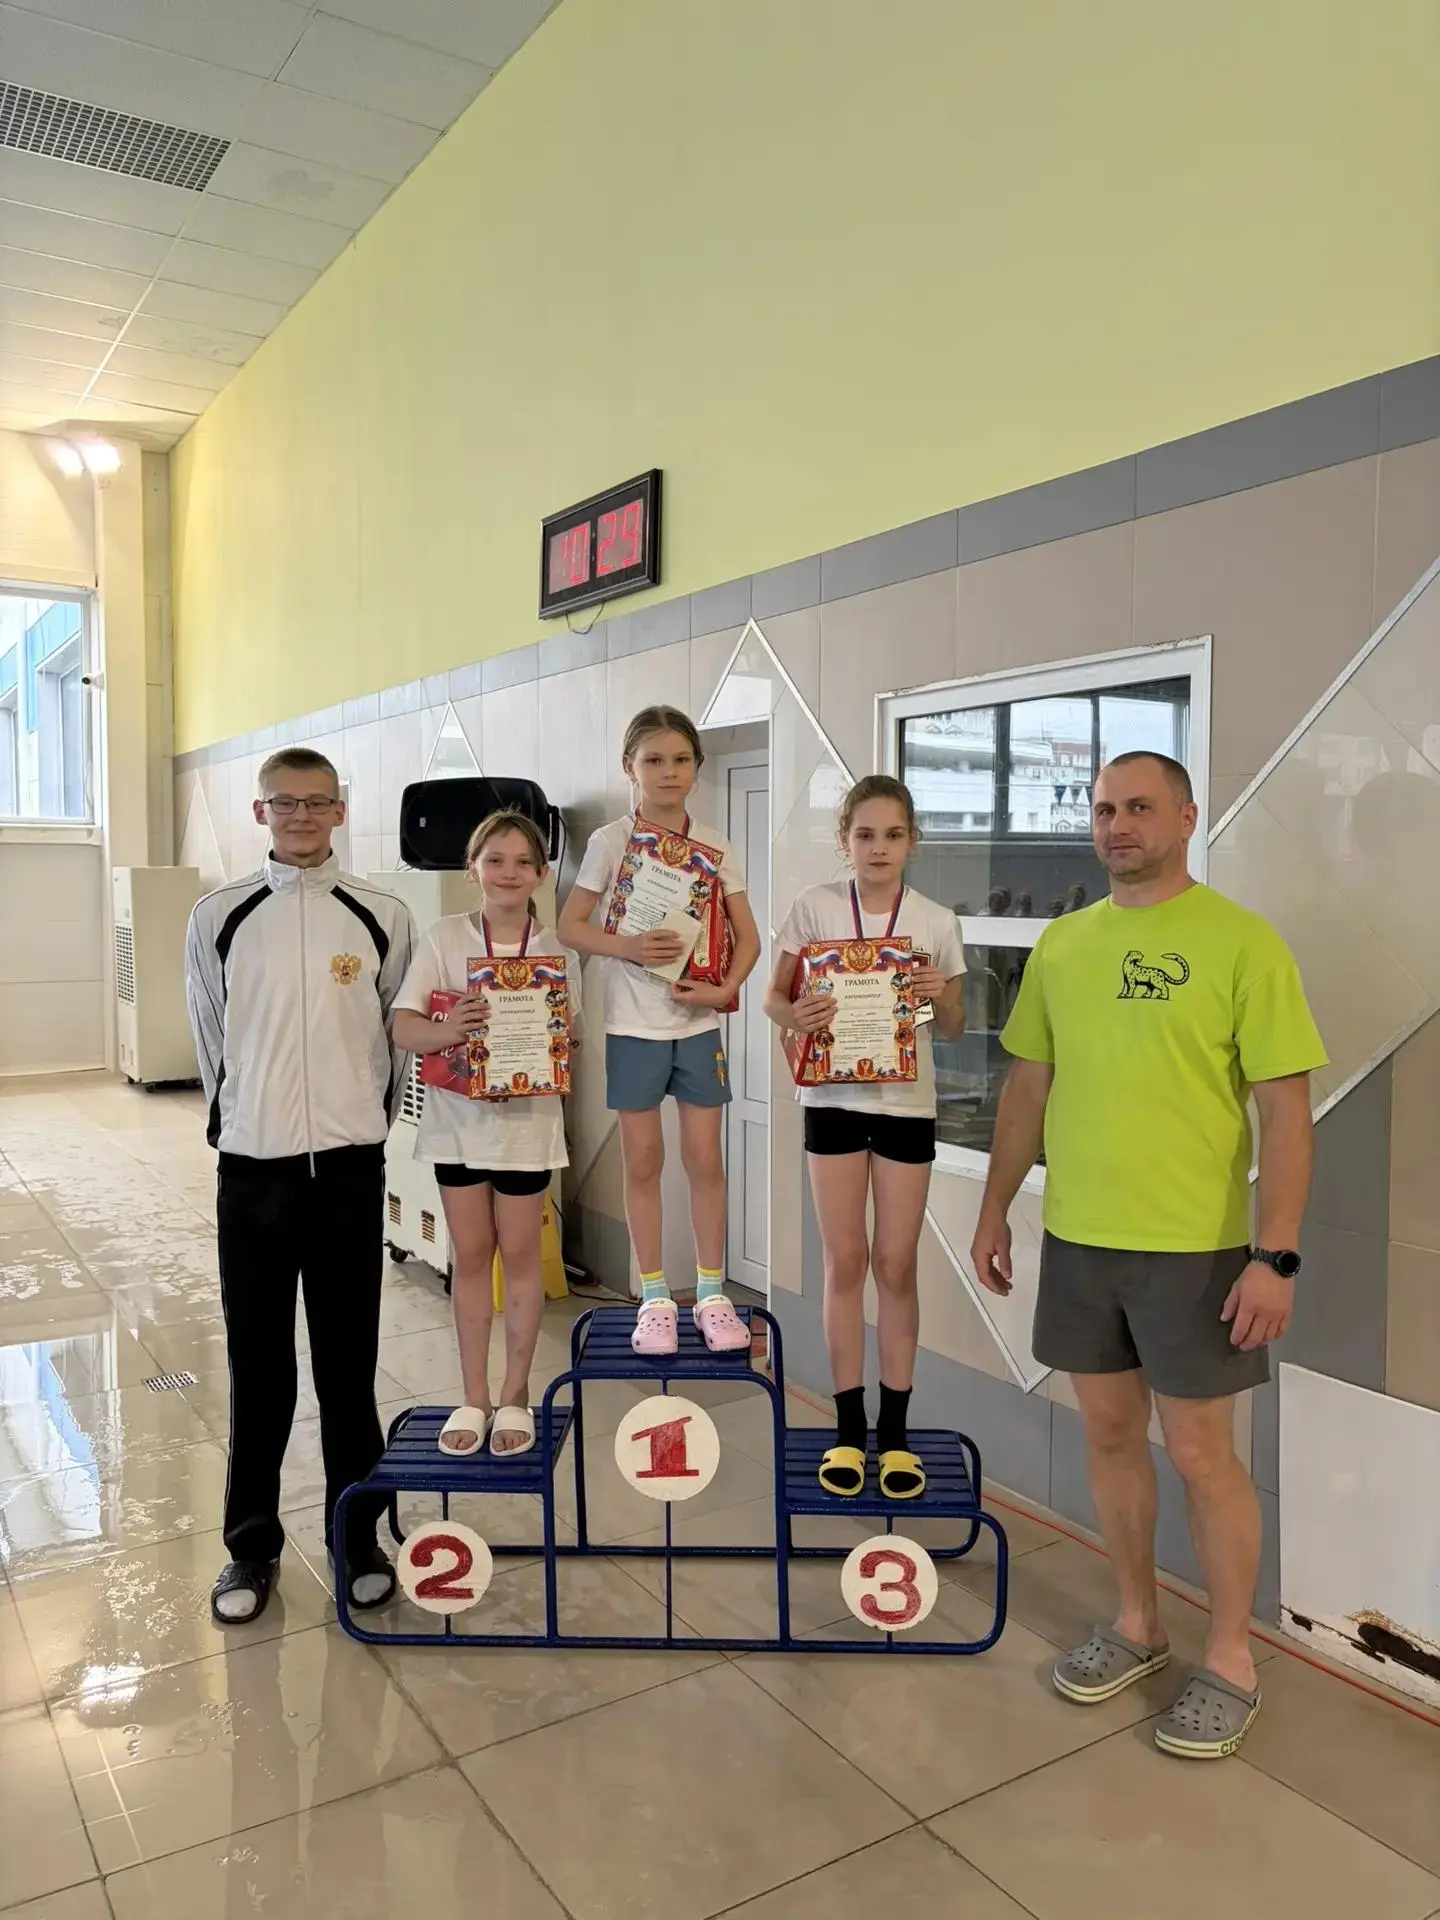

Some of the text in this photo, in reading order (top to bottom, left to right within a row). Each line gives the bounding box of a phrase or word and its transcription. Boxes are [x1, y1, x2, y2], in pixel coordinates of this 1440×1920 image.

[651, 865, 681, 882] ГРАМОТА
[499, 995, 534, 1003] ГРАМОТА
[844, 979, 880, 987] ГРАМОТА
[631, 1416, 700, 1478] 1
[410, 1534, 475, 1600] 2
[860, 1549, 922, 1625] 3
